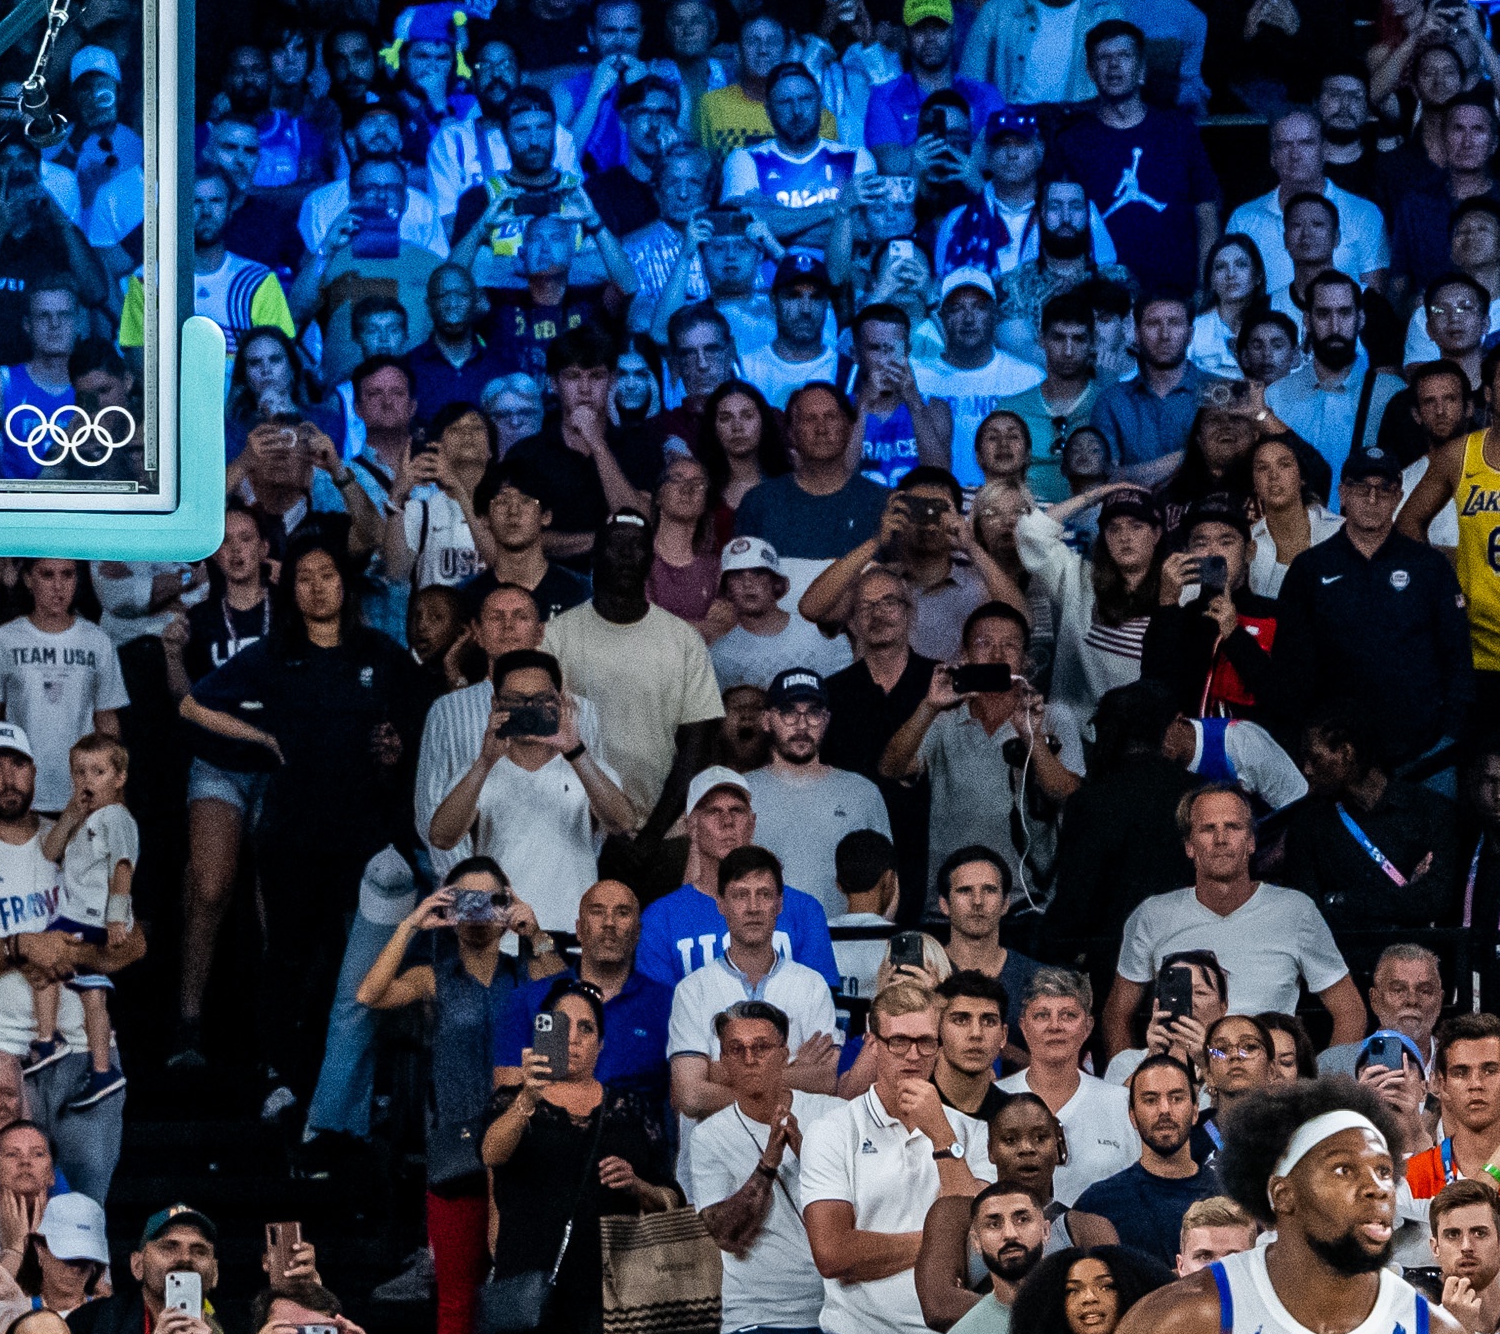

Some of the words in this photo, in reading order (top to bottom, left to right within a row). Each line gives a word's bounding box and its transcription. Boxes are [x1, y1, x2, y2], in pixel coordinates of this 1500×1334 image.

[10, 649, 52, 666] TEAM
[62, 649, 94, 667] USA
[784, 673, 820, 690] FRANCE
